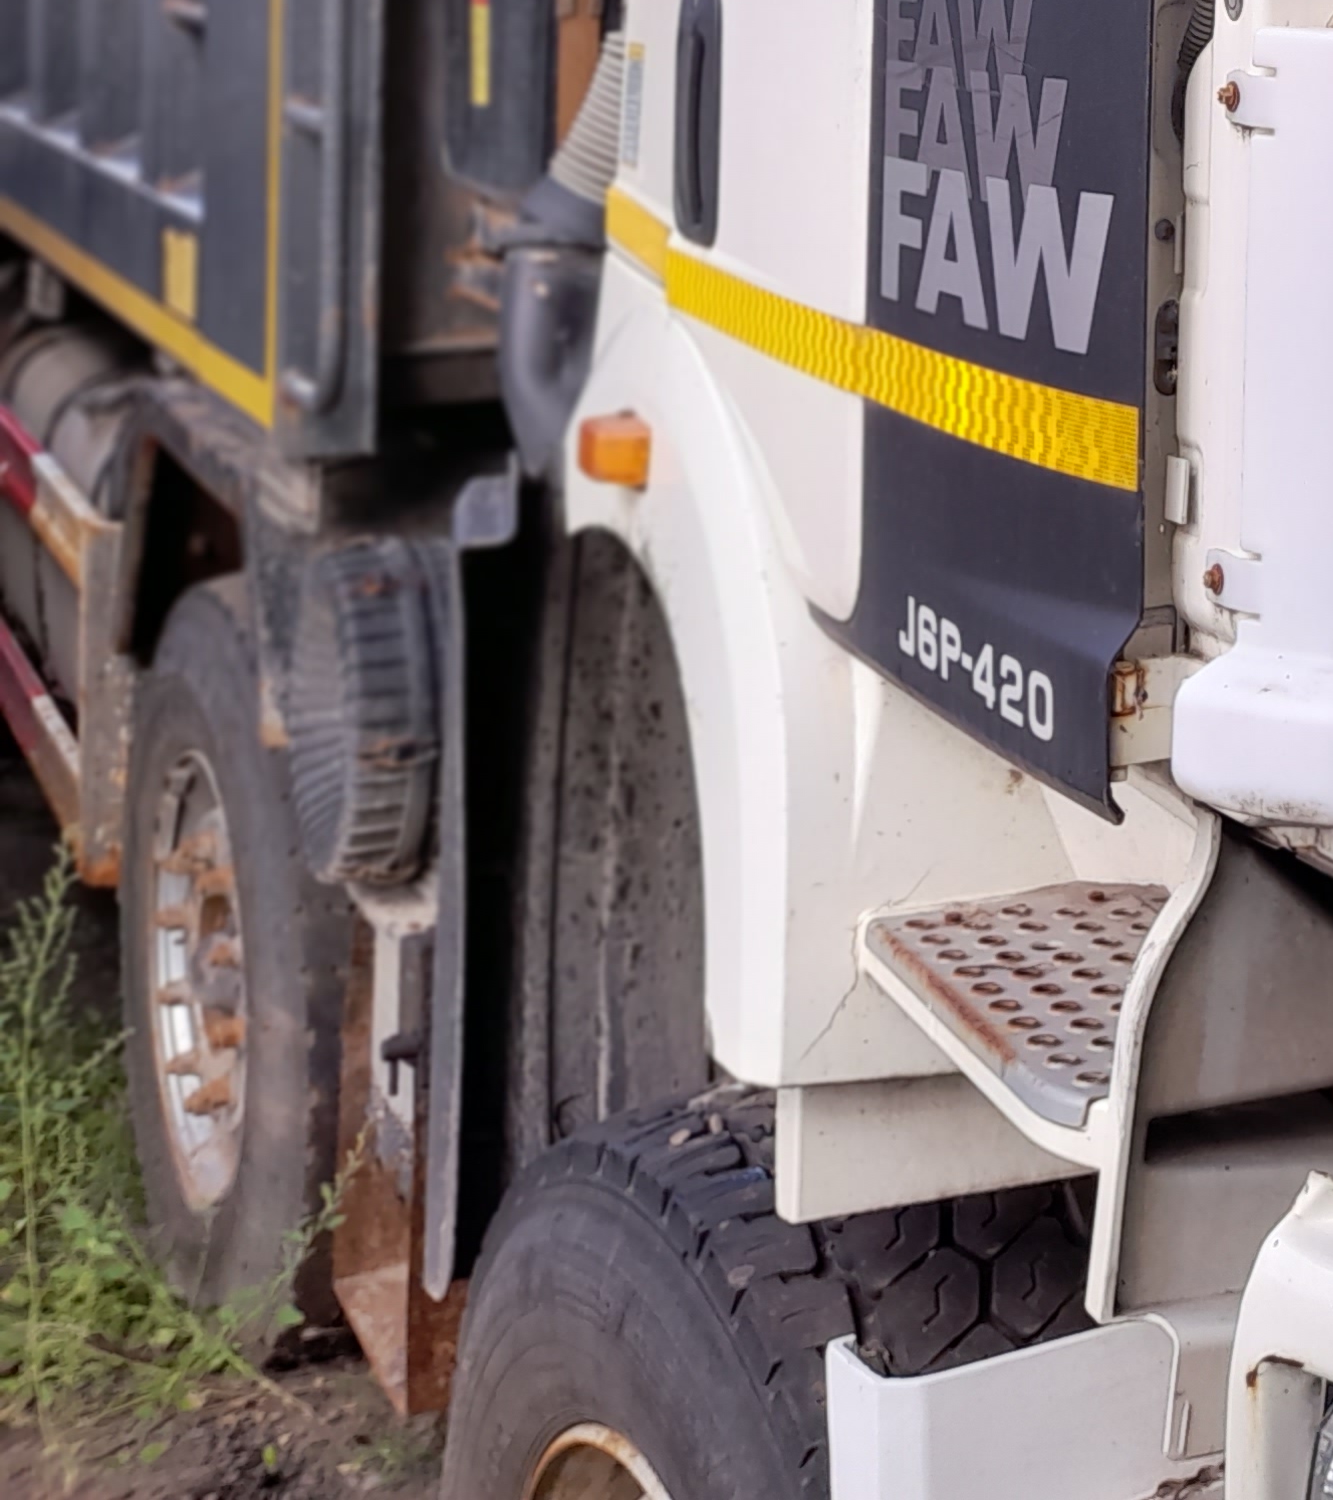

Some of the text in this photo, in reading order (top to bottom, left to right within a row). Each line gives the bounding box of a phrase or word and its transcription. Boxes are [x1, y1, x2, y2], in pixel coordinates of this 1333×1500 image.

[884, 58, 1068, 214] FAW
[880, 154, 1115, 356] FAW
[898, 594, 1055, 742] J6P-420
